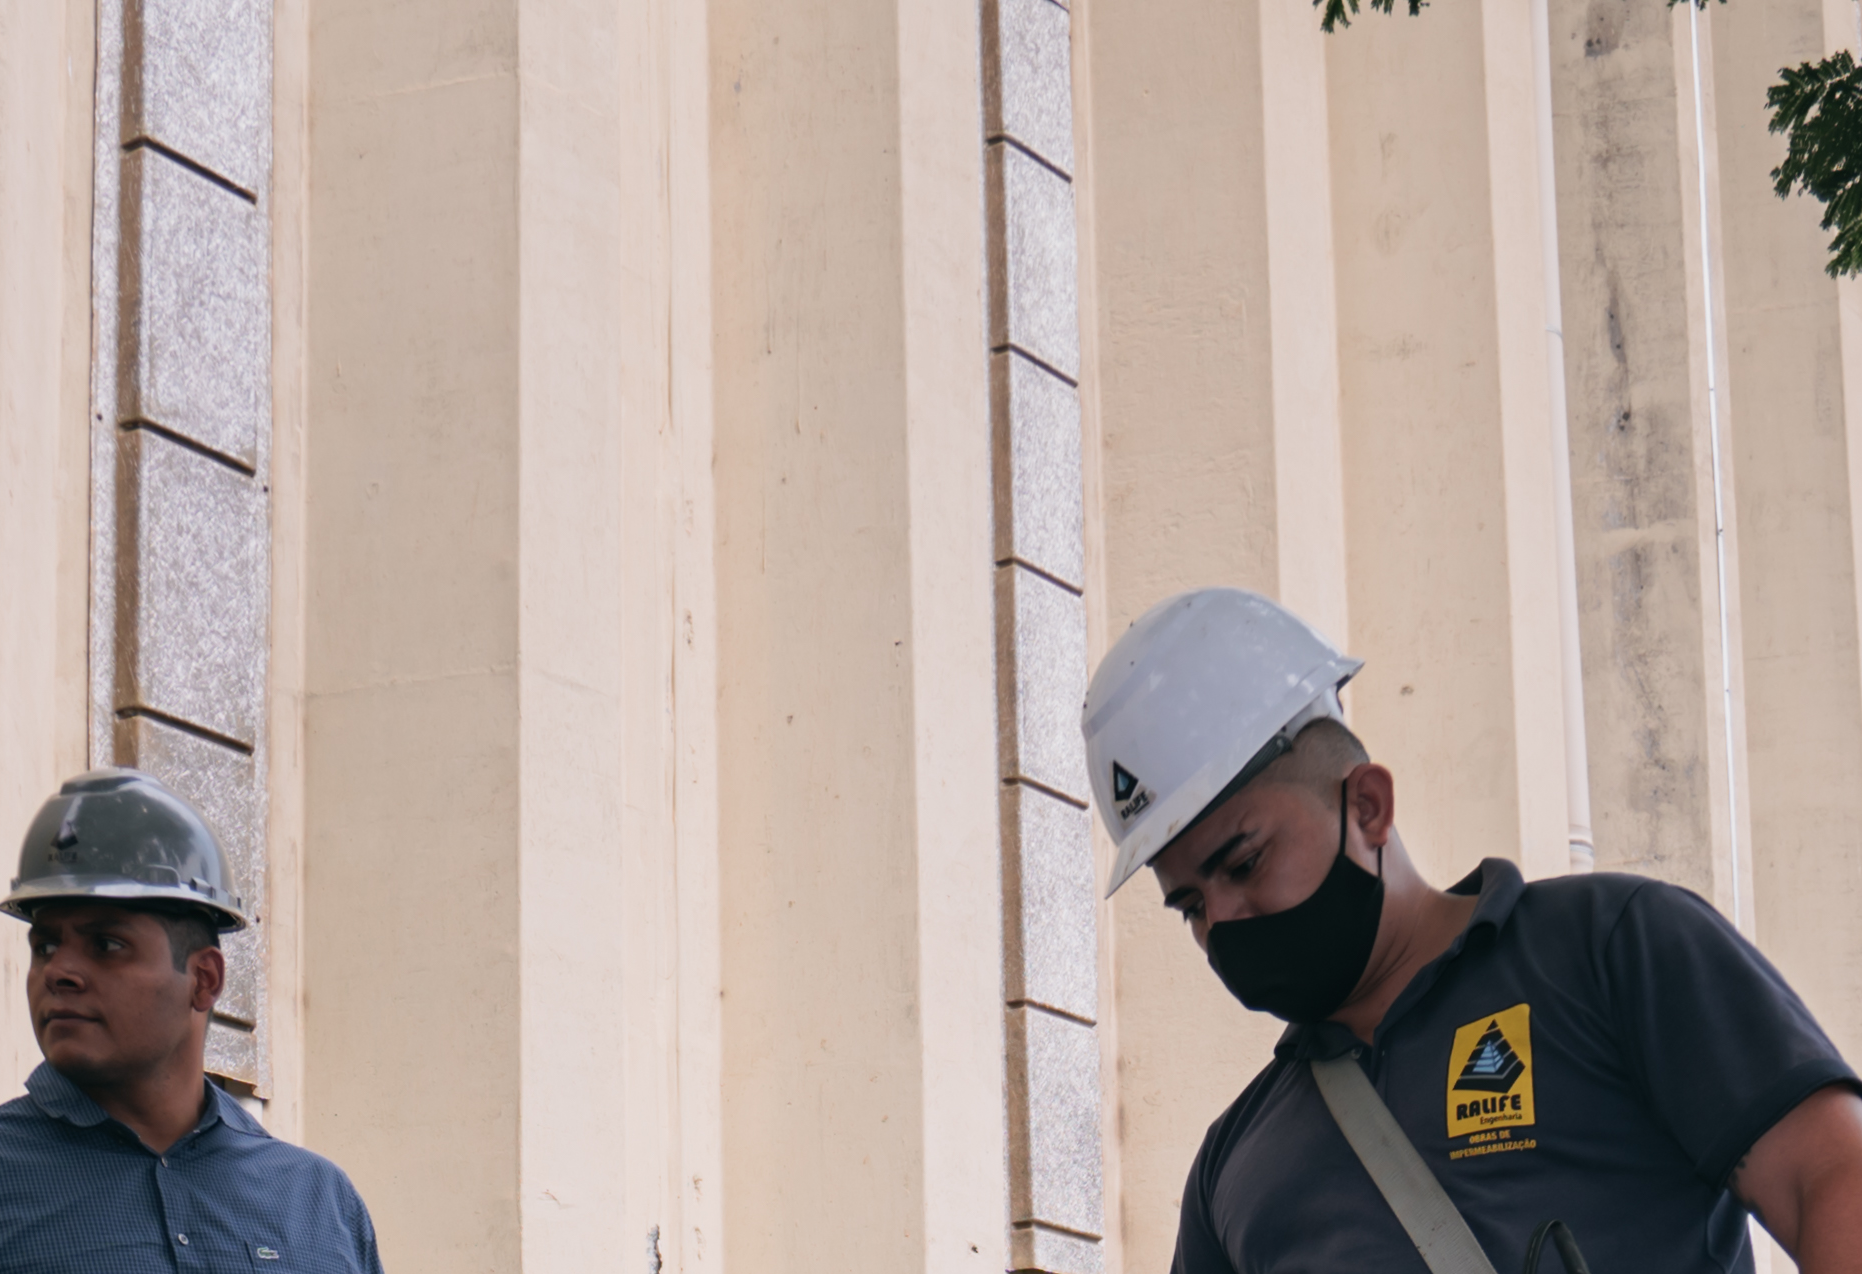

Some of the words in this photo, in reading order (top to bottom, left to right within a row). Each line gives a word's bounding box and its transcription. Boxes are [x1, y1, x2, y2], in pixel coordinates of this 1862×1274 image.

[1120, 791, 1149, 820] RALIFE
[1455, 1093, 1523, 1121] RALIFE
[1480, 1113, 1523, 1125] Engenharia
[1469, 1130, 1497, 1144] OBRAS
[1499, 1129, 1512, 1139] DE
[1449, 1138, 1537, 1160] IMPERMEABILIZAÇÃO
